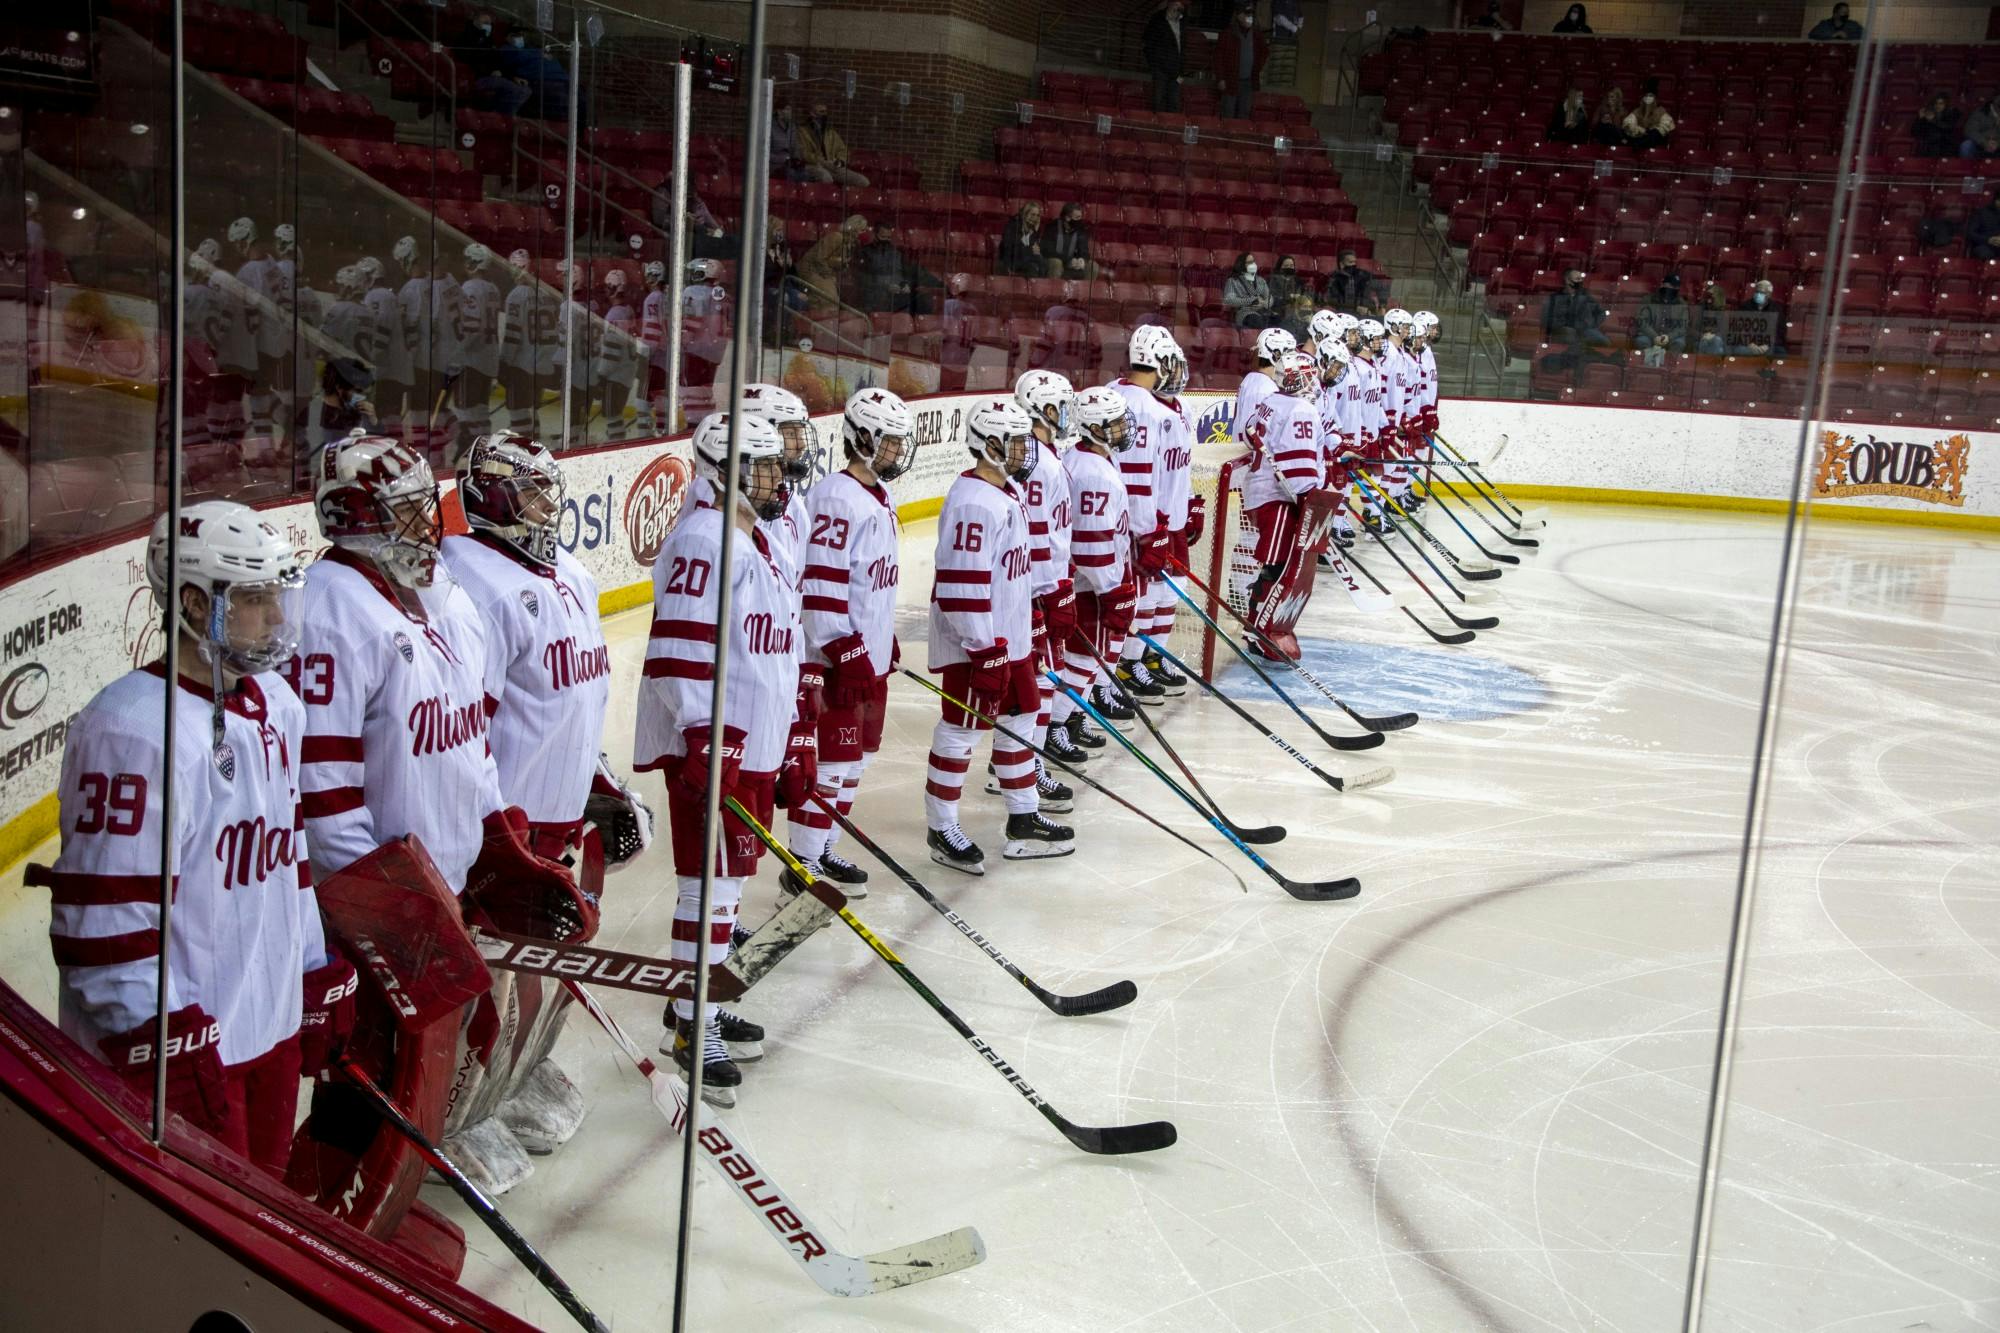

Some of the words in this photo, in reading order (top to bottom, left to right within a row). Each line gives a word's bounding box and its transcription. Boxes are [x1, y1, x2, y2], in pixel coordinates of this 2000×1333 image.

[916, 410, 942, 446] GEAR
[1293, 421, 1313, 439] 36
[1080, 491, 1110, 516] 67
[287, 525, 307, 547] The
[810, 514, 850, 551] 23
[952, 521, 984, 553] 16
[126, 559, 145, 586] The
[665, 556, 712, 598] 20
[4, 616, 46, 663] HOME
[75, 772, 148, 837] 39
[698, 1126, 827, 1262] BAUER
[256, 1211, 298, 1235] CAUTION
[299, 1234, 335, 1258] MOVING
[335, 1254, 367, 1274] GLASS
[364, 1271, 403, 1296] SYSTEM
[405, 1294, 435, 1311] STAY
[429, 1308, 460, 1327] BACK
